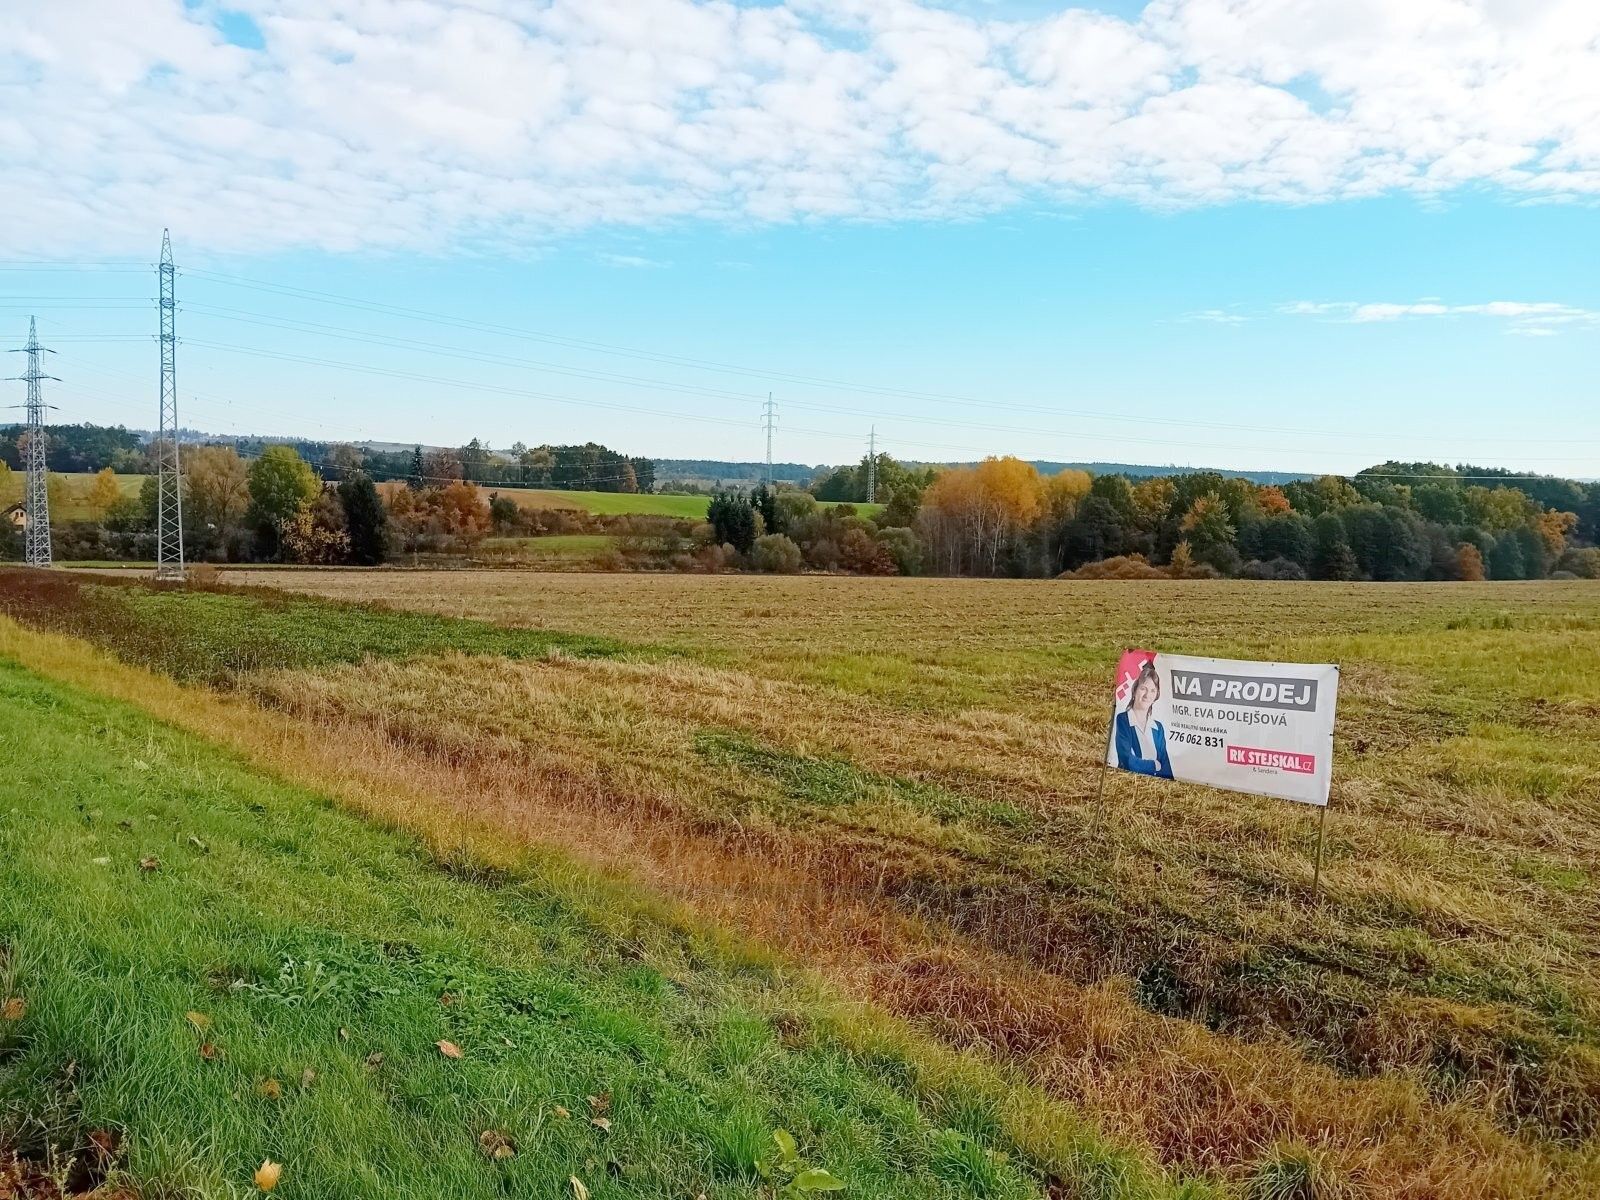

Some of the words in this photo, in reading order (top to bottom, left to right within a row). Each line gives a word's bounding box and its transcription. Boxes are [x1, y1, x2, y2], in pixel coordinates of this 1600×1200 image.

[1173, 675, 1202, 696] NA
[1210, 679, 1311, 705] PRODEJ
[1172, 704, 1192, 717] MGR.
[1194, 707, 1214, 719] EVA
[1217, 709, 1288, 726] DOLEJŠOVÁ
[1169, 730, 1185, 742] 776
[1186, 733, 1202, 746] 062
[1204, 736, 1224, 748] 831
[1229, 748, 1245, 763] RK
